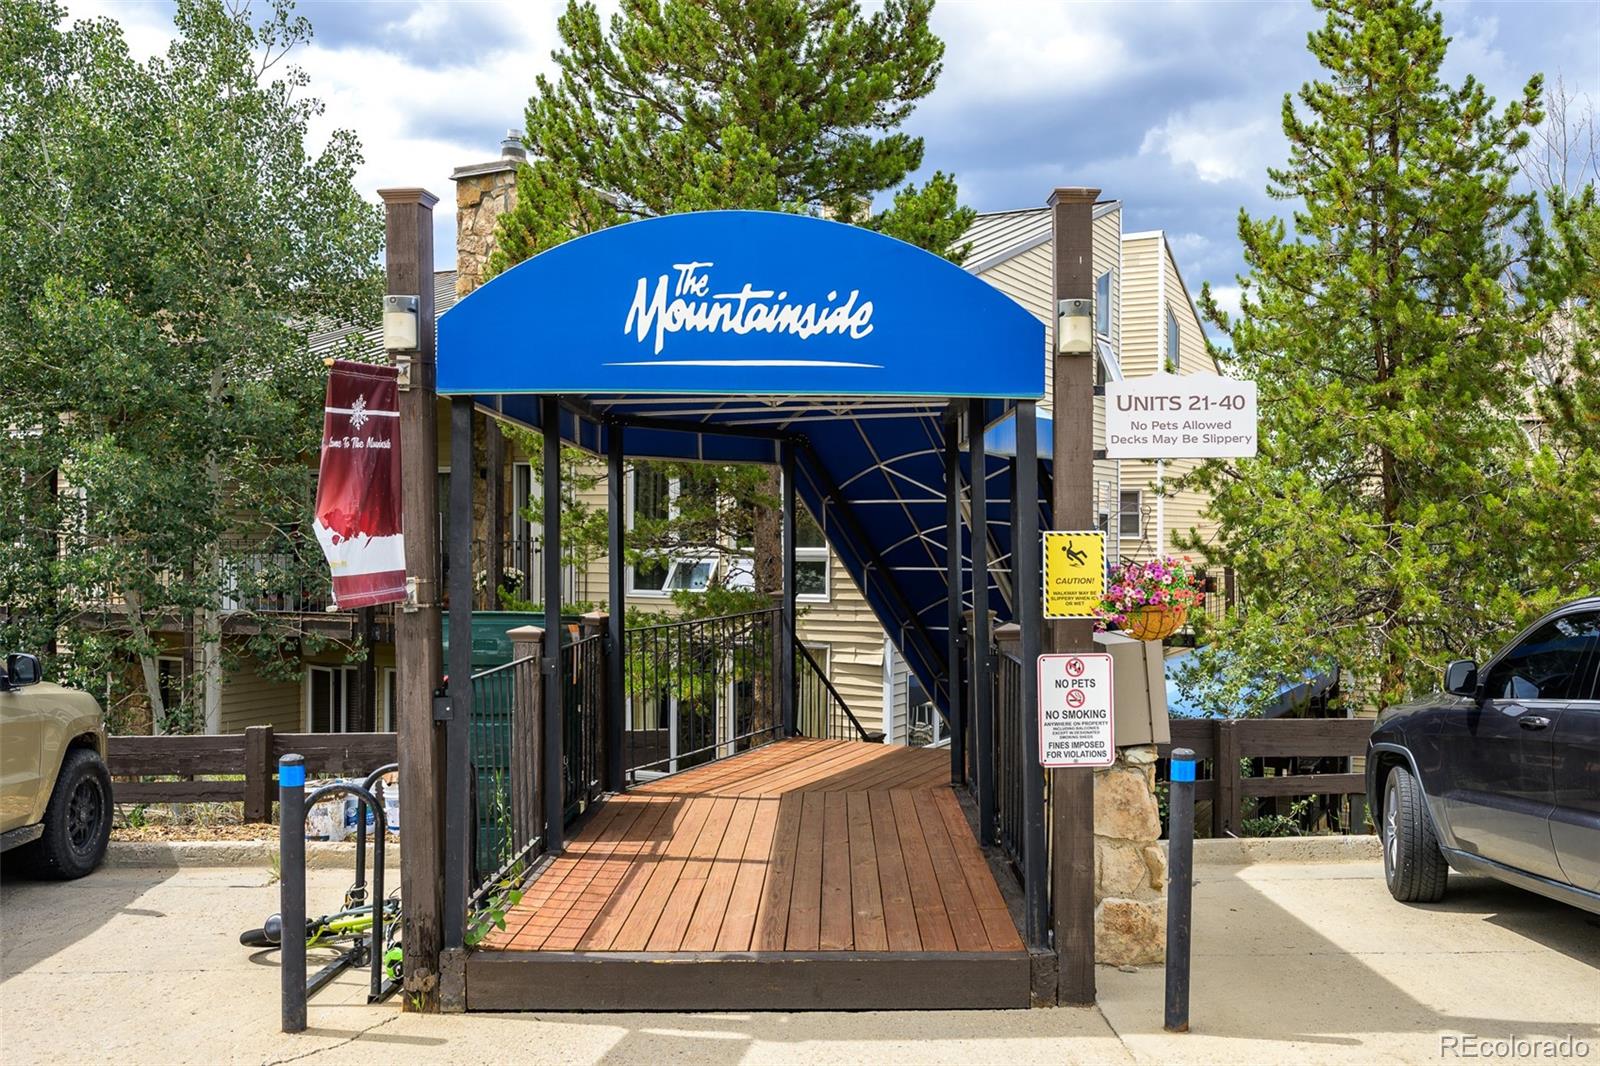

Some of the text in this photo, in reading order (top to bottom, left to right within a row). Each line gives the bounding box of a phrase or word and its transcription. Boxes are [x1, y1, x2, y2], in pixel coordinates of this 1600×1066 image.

[672, 261, 714, 297] The
[623, 274, 875, 356] Mountainside
[1116, 395, 1246, 412] UNITS 21-40
[1130, 420, 1232, 431] No Pets Allowed
[1111, 433, 1252, 446] Decks May Be Slippery
[1055, 679, 1096, 688] NO PETS
[1045, 710, 1107, 719] NO SMOKING
[1071, 741, 1105, 749] IMPOSED
